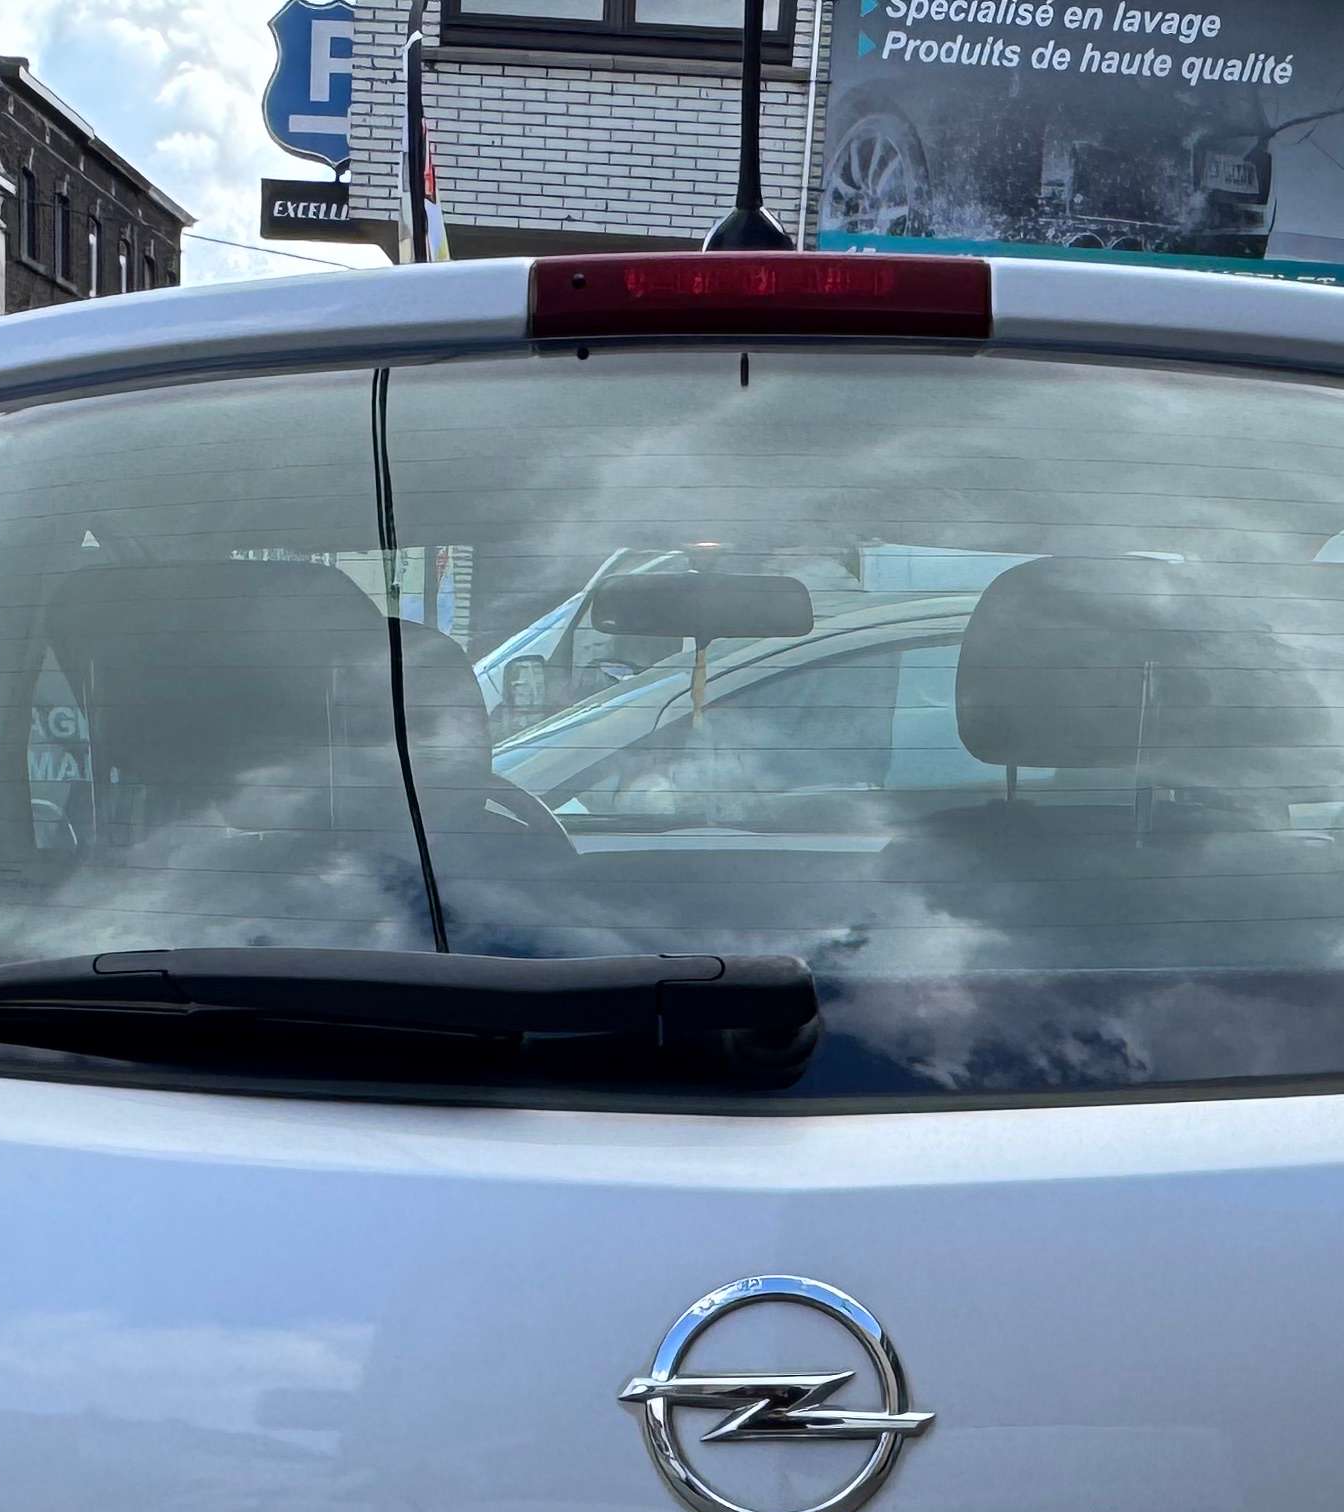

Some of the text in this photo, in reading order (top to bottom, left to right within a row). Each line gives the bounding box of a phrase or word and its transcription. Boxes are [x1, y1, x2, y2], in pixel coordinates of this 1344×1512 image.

[1063, 8, 1103, 32] en
[1112, 2, 1222, 44] lavage
[881, 31, 1294, 86] Produits de haute qualité
